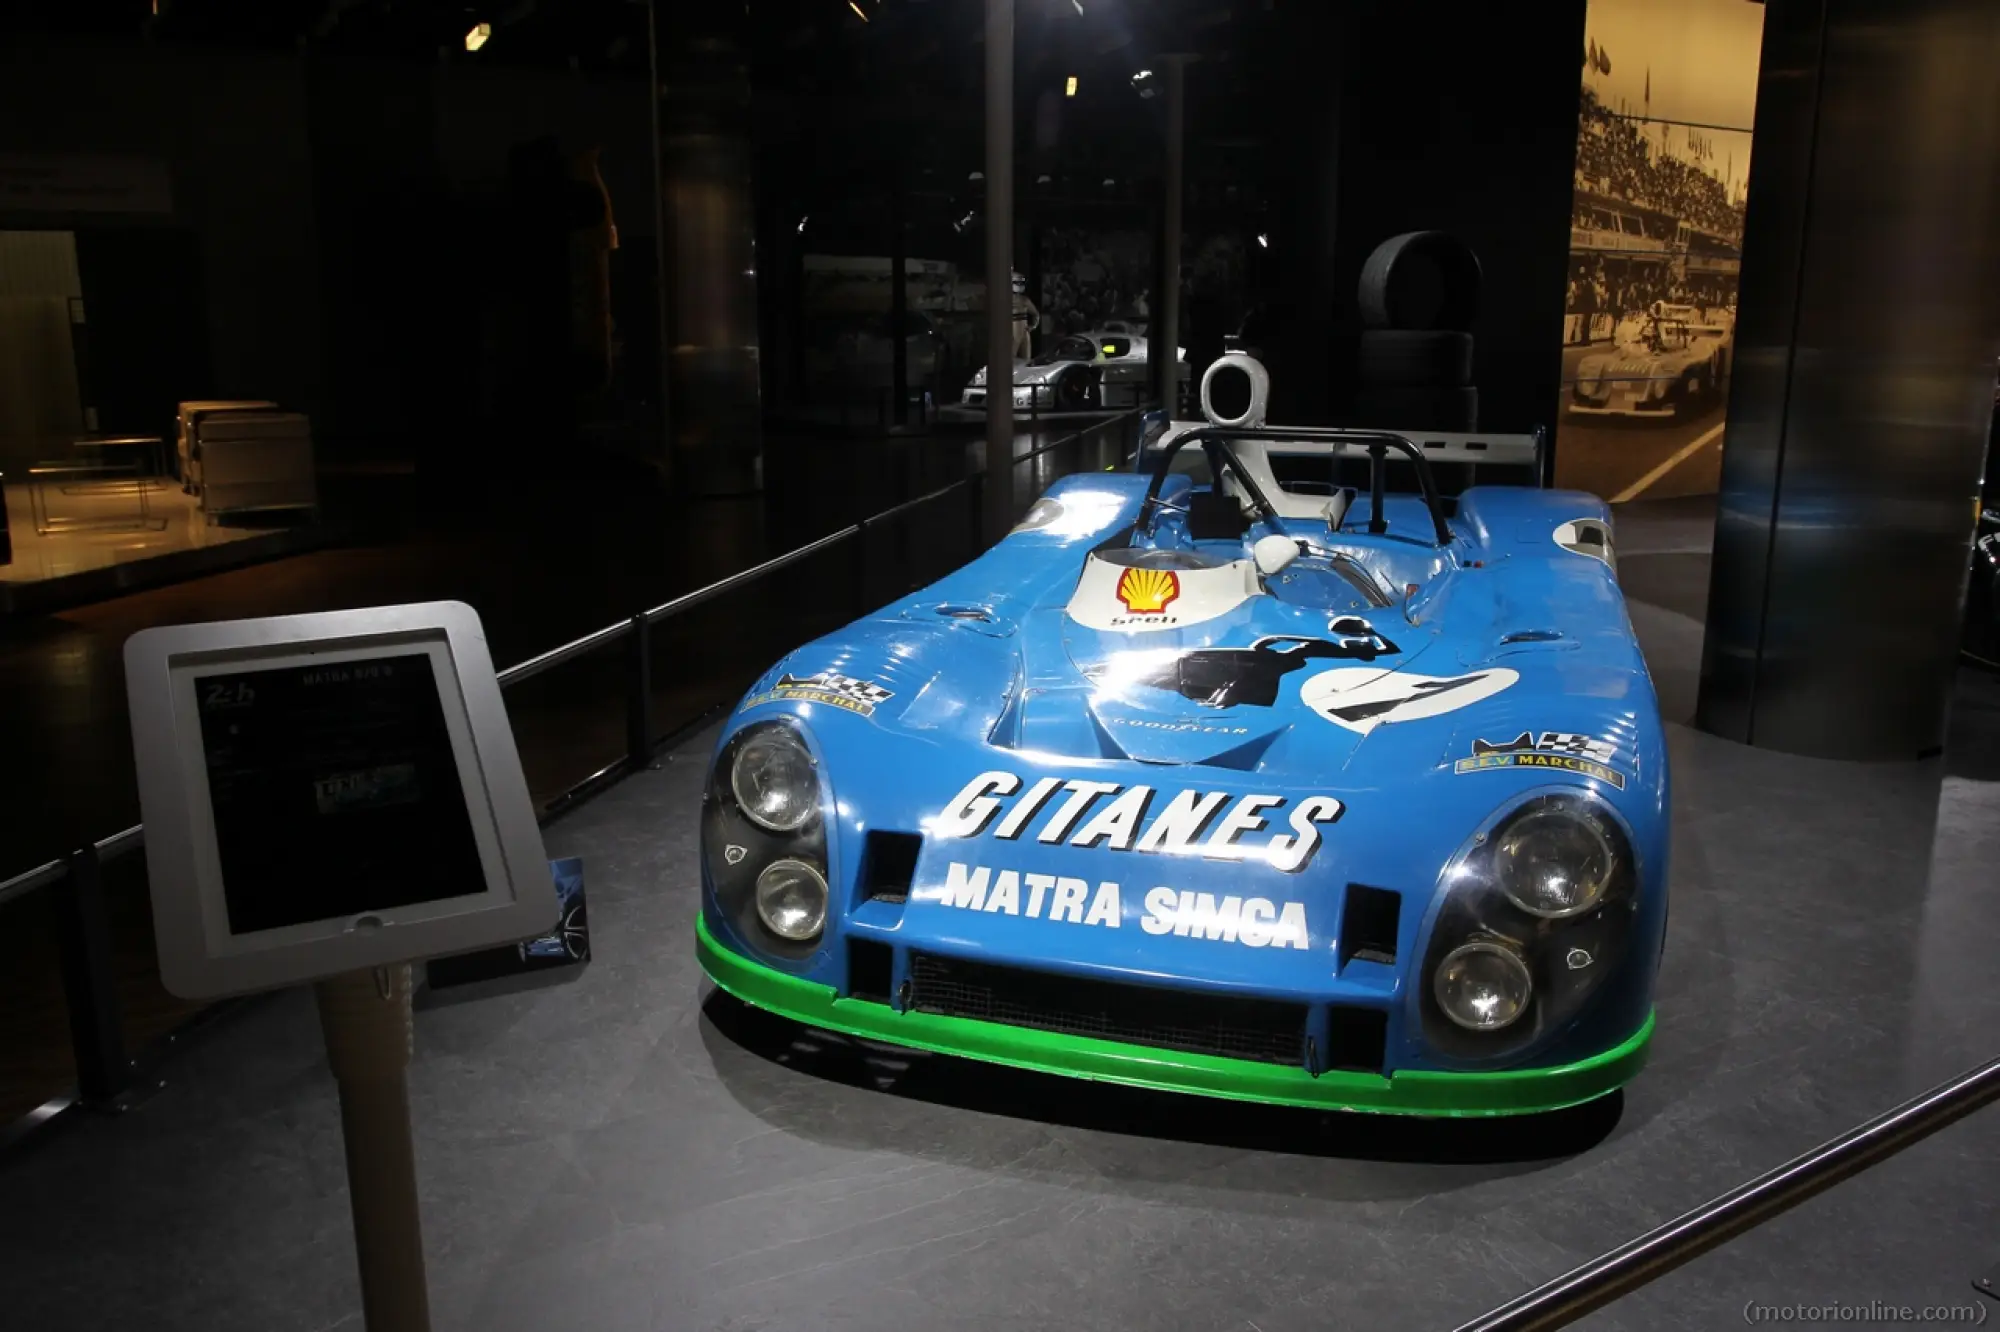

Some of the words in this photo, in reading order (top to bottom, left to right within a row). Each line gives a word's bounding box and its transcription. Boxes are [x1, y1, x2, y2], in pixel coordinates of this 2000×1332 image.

[1518, 755, 1618, 783] MARCHAL
[937, 771, 1346, 873] GITANES
[940, 861, 1121, 929] MATRA
[1140, 887, 1310, 950] SIMCA
